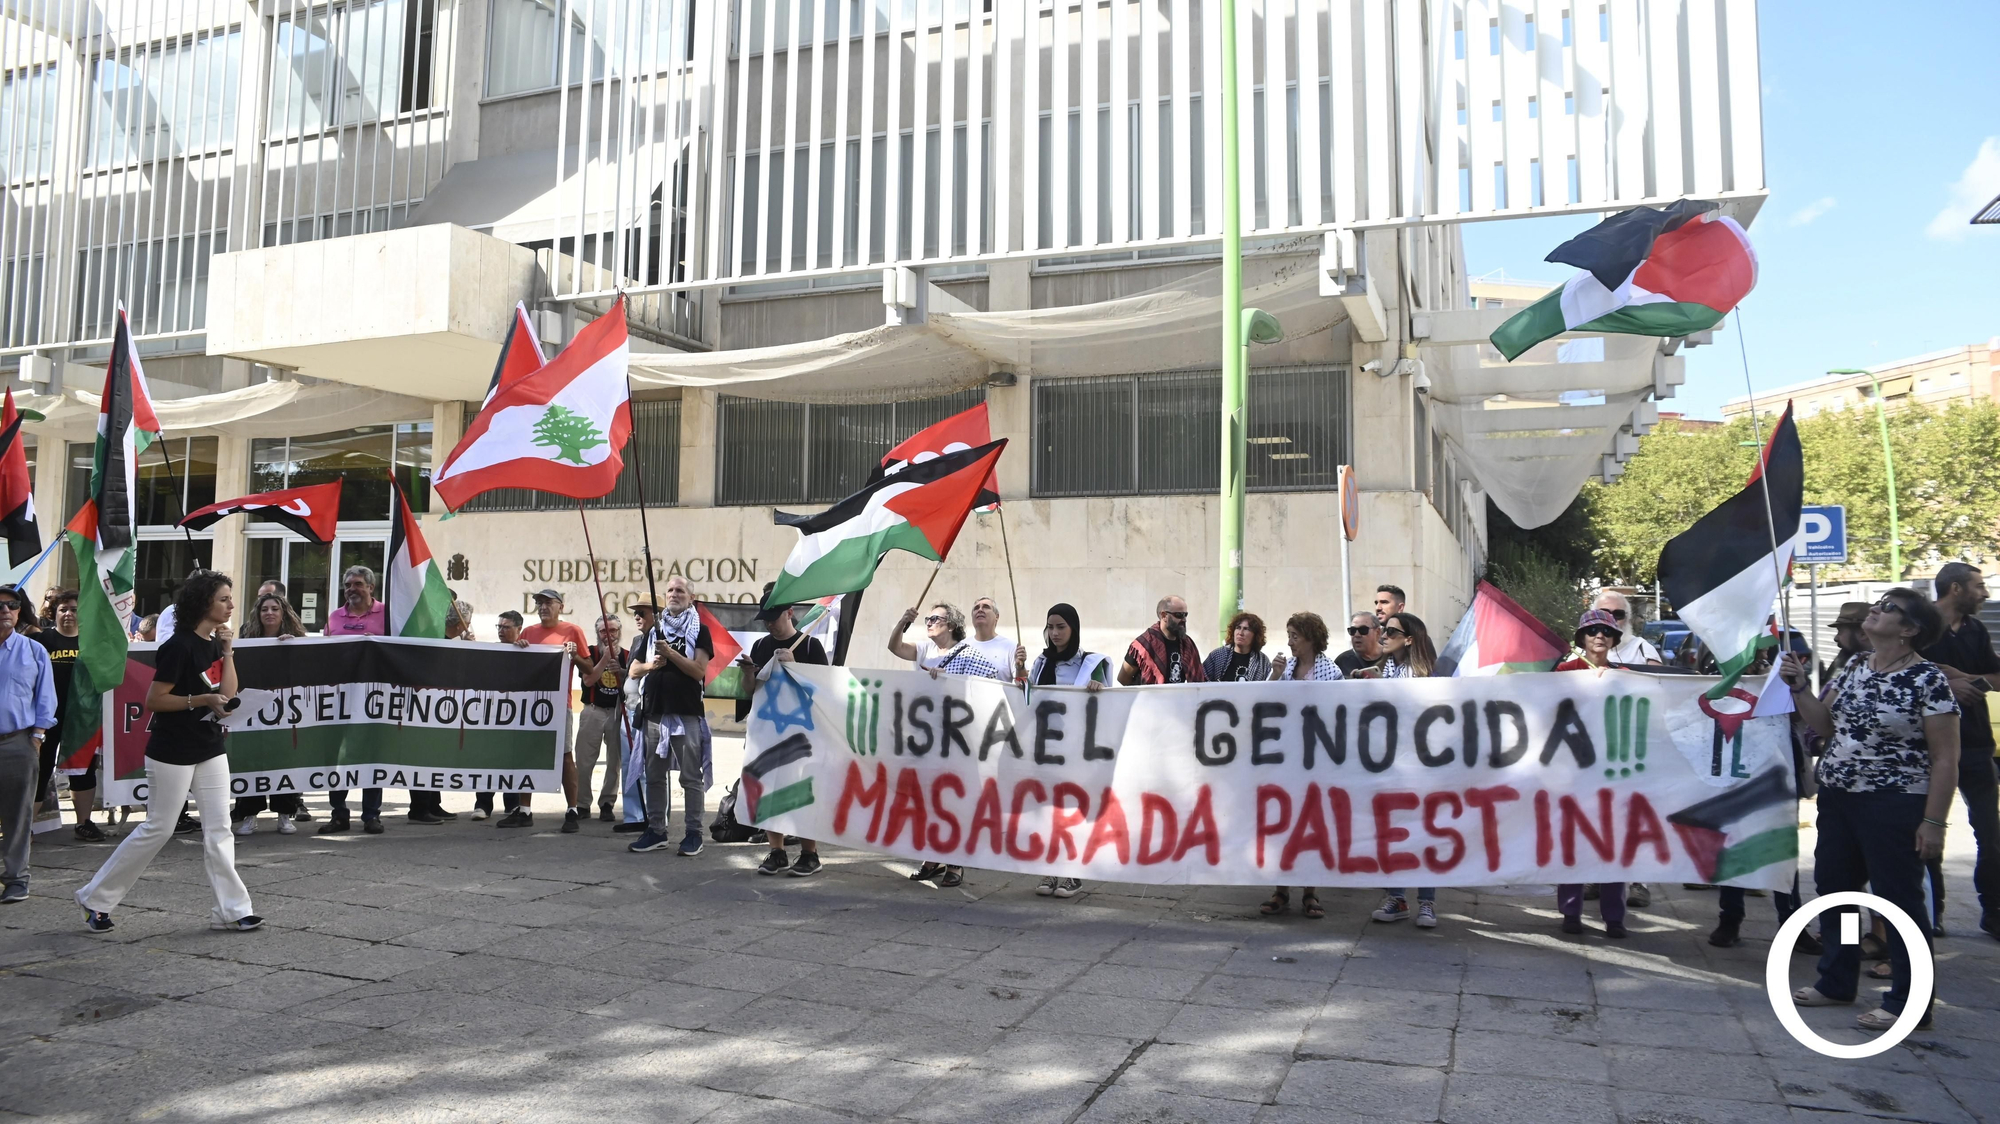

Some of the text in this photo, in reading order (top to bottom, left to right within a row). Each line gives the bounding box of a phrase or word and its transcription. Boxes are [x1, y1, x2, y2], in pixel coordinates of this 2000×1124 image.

[1794, 513, 1832, 556] P
[319, 691, 351, 722] EL
[364, 689, 554, 727] GENOCIDIO
[309, 769, 359, 789] CON
[372, 768, 536, 791] PALESTINA
[833, 759, 1671, 874] MASACRADA PALESTINA
